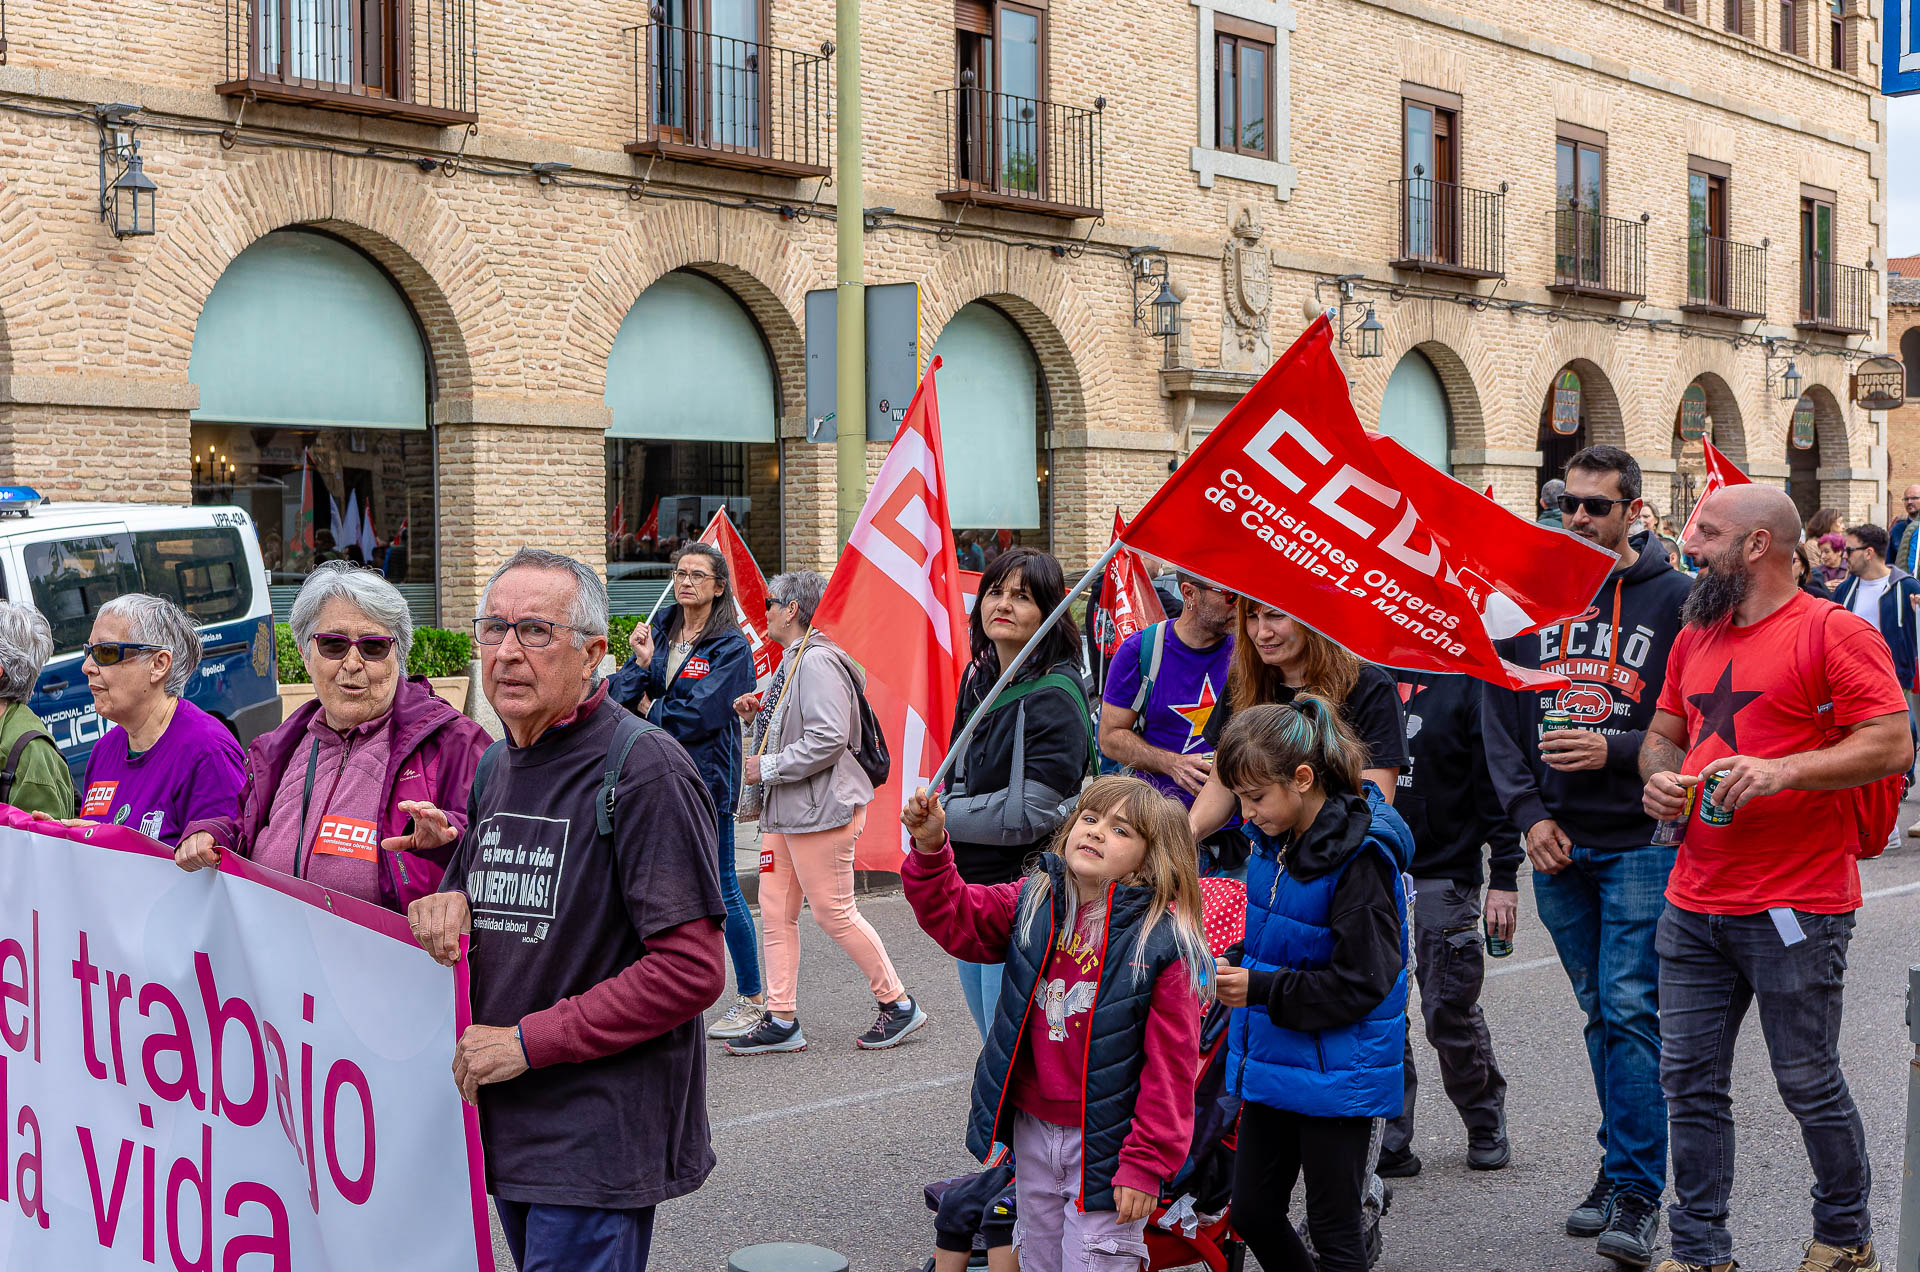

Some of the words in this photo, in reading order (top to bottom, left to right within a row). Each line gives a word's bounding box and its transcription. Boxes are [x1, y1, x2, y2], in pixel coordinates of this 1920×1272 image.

[1858, 373, 1902, 385] BURGER
[1857, 384, 1902, 400] KING
[892, 408, 908, 421] VOL
[1243, 408, 1463, 588] CCO
[1220, 468, 1359, 573] Comisiones
[1363, 569, 1460, 630] Obreras
[1204, 486, 1236, 513] de
[1241, 510, 1368, 598] Castilla-La
[1370, 597, 1467, 657] Mancha
[1546, 662, 1631, 684] UNLIMITED
[1540, 697, 1554, 709] EST.
[40, 707, 82, 724] NACIONAL
[515, 845, 526, 864] la
[529, 847, 554, 867] vida
[519, 867, 551, 908] MÁS!
[0, 909, 41, 1063] el
[72, 930, 376, 1216] trabajo
[76, 1103, 291, 1272] vida
